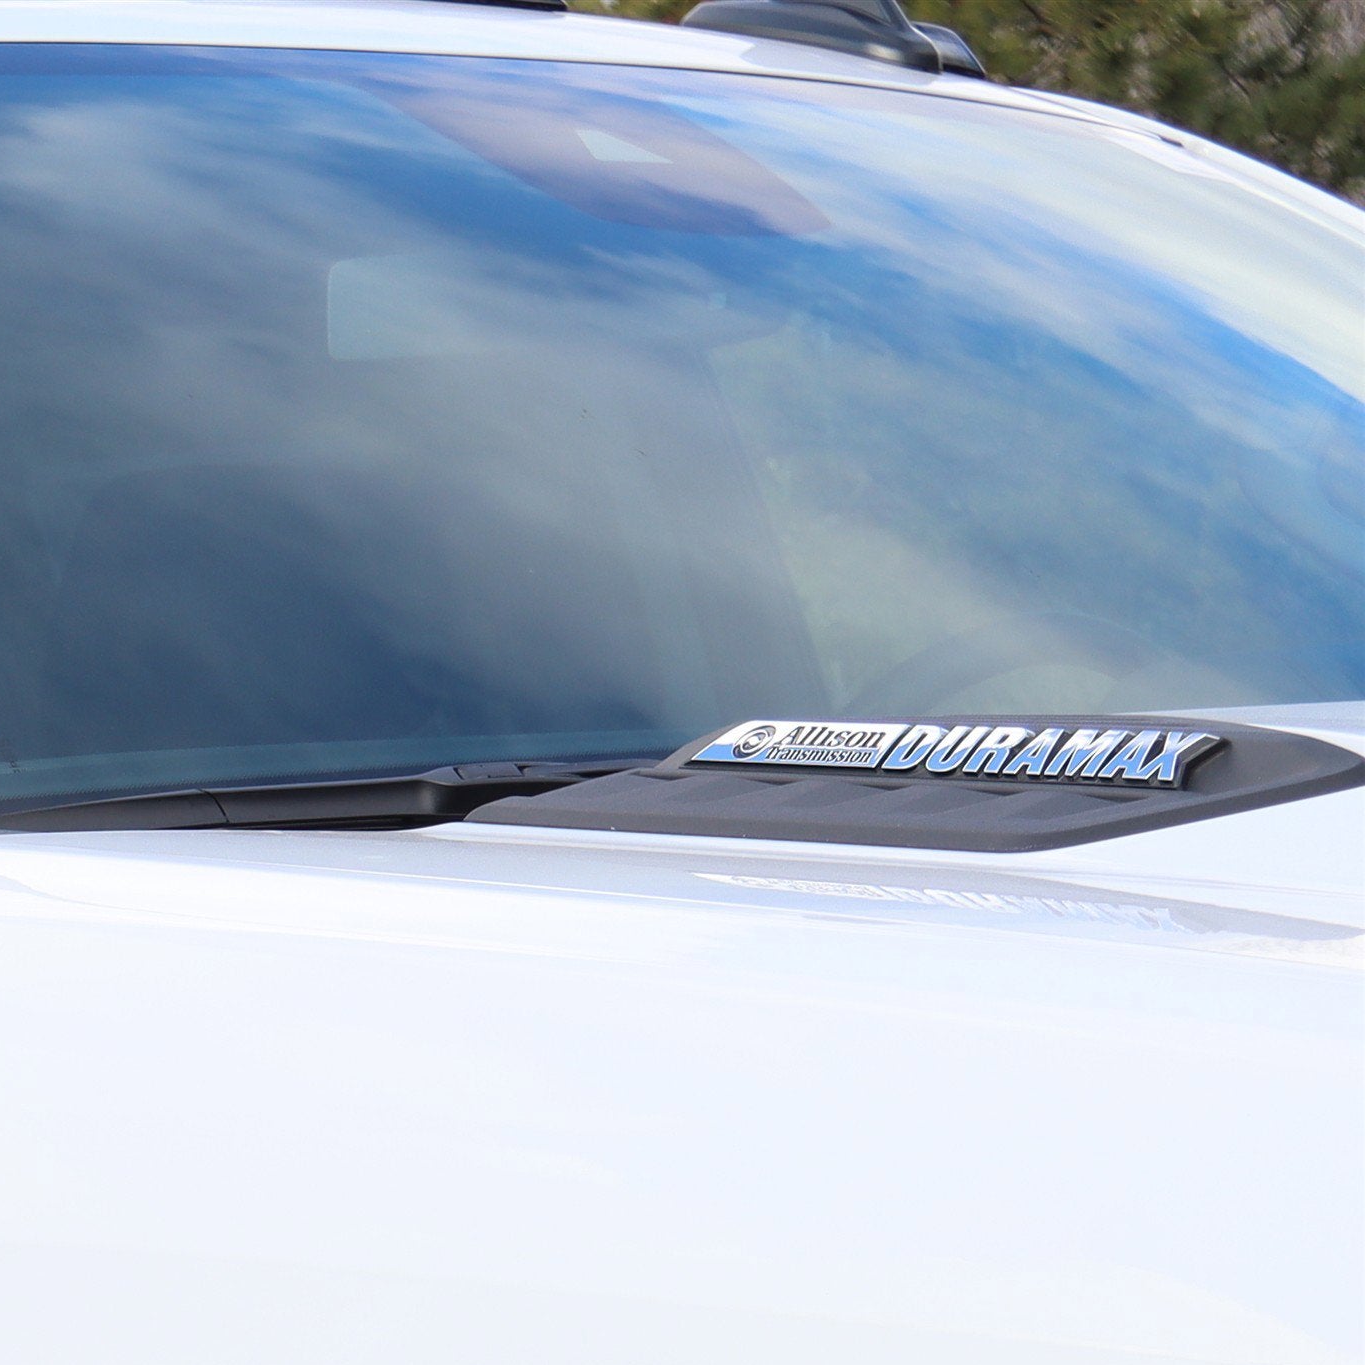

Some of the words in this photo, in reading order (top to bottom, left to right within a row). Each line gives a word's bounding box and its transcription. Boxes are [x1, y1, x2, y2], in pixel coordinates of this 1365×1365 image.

[773, 725, 887, 749] Allison
[765, 745, 874, 764] Transmission
[881, 723, 1221, 782] DURAMAX
